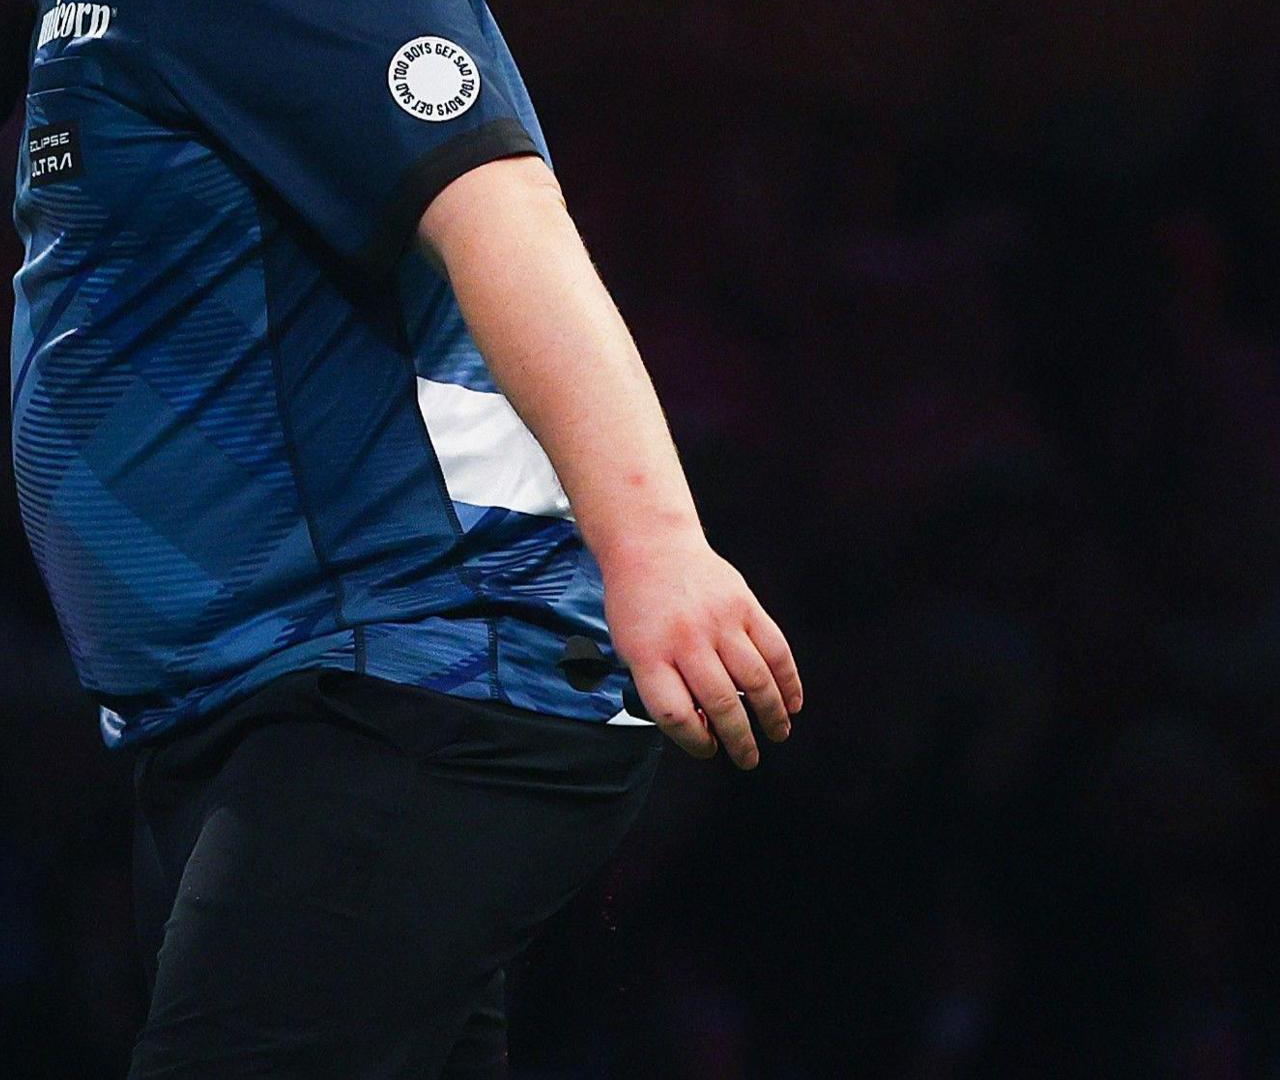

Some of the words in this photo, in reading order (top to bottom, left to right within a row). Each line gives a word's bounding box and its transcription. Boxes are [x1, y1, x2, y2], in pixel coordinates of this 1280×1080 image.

[403, 42, 432, 62] BOYS
[435, 43, 457, 59] GET
[453, 56, 473, 76] SAD
[393, 60, 410, 81] TOO
[395, 83, 415, 104] SAD
[411, 100, 433, 116] GET
[436, 96, 466, 116] BOYS
